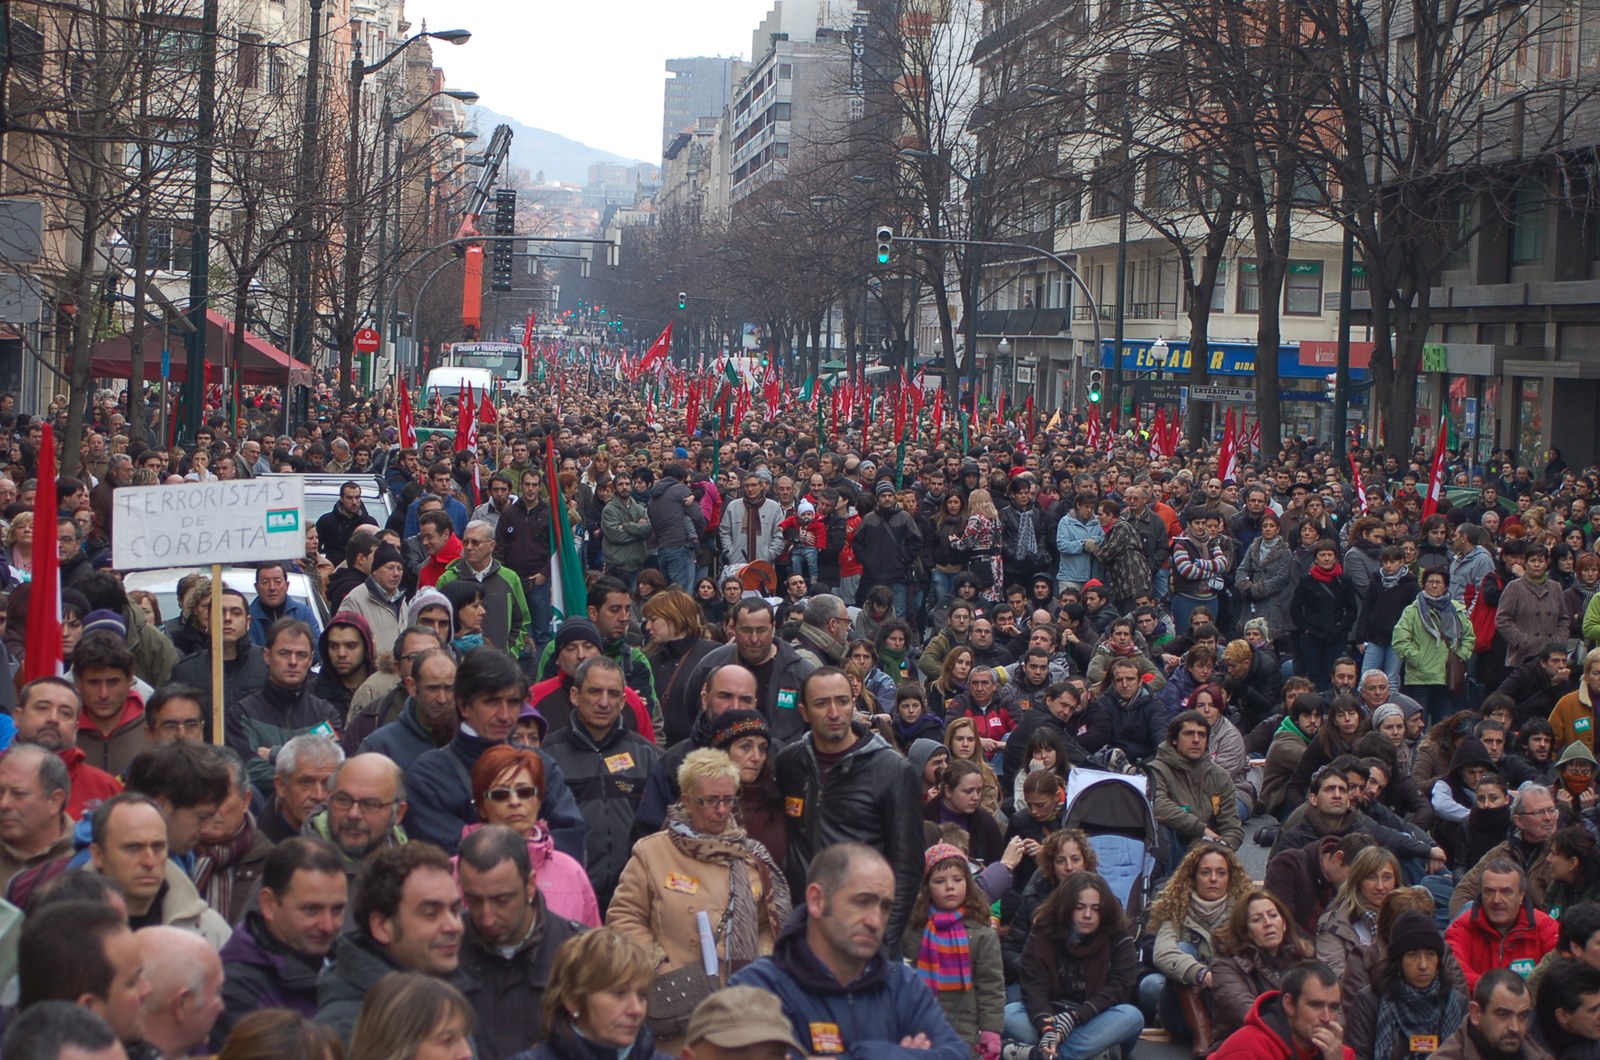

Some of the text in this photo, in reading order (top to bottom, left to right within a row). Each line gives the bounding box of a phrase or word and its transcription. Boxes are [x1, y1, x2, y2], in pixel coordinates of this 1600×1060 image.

[1136, 347, 1224, 370] ECADR
[1233, 361, 1255, 371] BIDA
[1194, 388, 1241, 396] ERTZAINTZA
[119, 480, 288, 516] TERRORISTAS
[181, 516, 206, 529] DE
[131, 526, 268, 558] CORBATA
